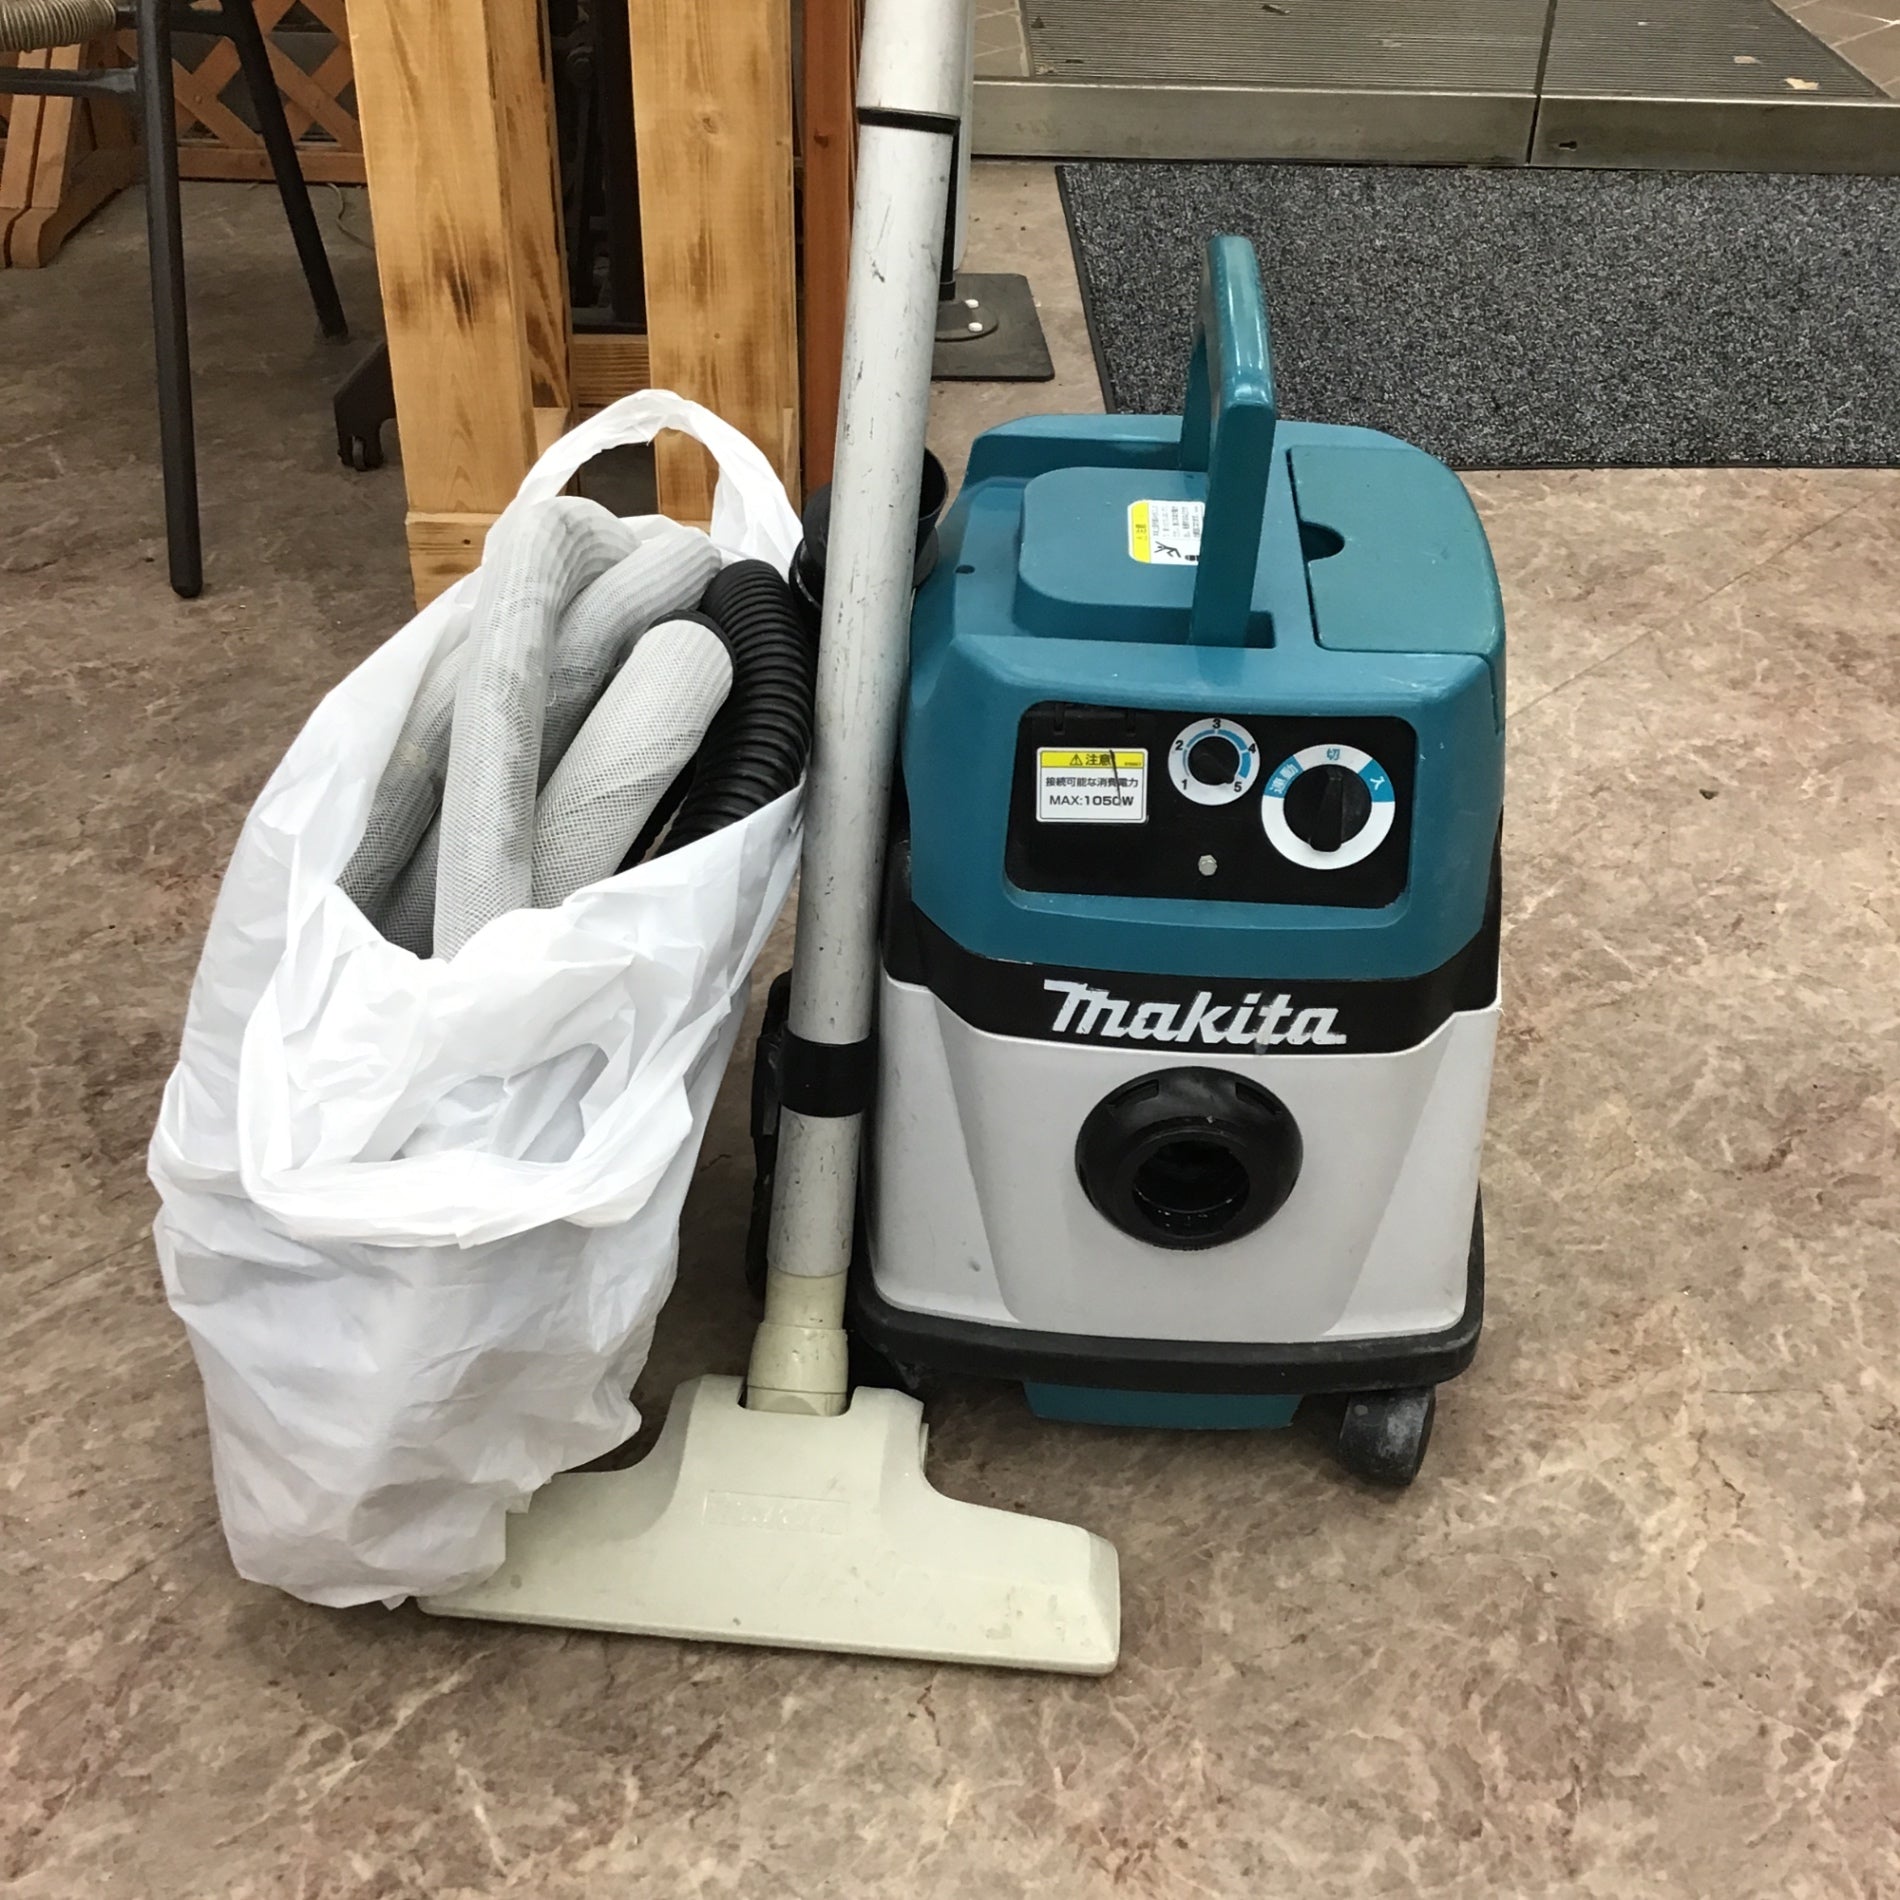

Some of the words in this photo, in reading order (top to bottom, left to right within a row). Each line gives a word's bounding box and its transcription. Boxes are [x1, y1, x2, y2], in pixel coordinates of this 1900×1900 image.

[1212, 718, 1221, 729] 3
[1175, 740, 1184, 751] 2
[1248, 743, 1257, 753] 4
[1085, 753, 1113, 766] 注意
[1326, 748, 1341, 761] 切
[1046, 776, 1139, 788] 接続可能な消費電力
[1181, 779, 1188, 790] 1
[1233, 781, 1243, 793] 5
[1369, 775, 1386, 791] 入
